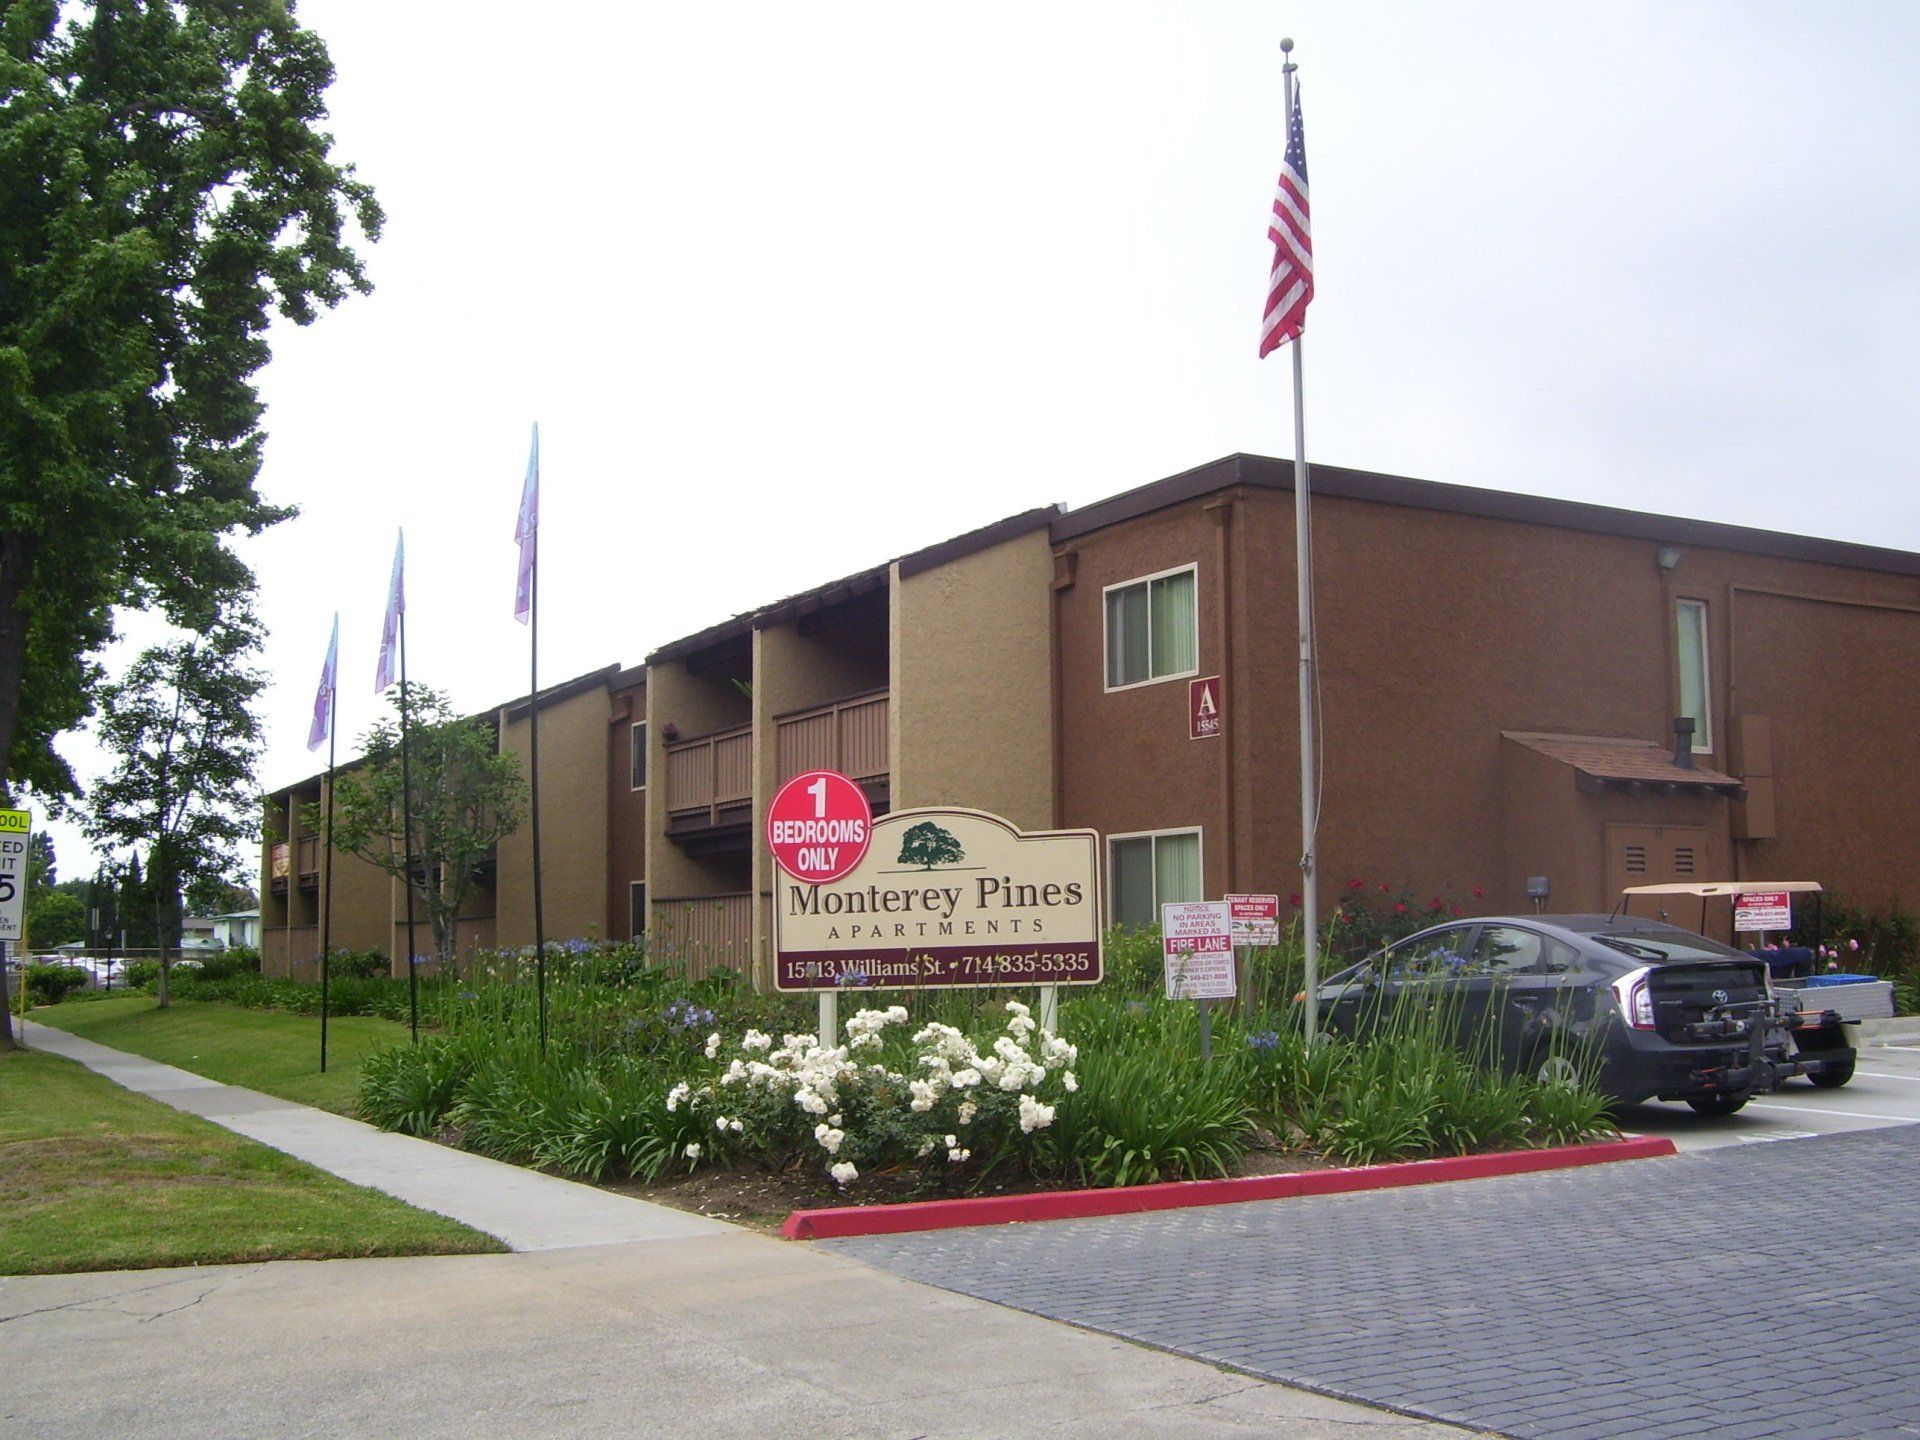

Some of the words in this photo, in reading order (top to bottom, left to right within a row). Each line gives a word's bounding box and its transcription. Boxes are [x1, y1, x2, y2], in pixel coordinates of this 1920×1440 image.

[1197, 682, 1217, 716] A
[1197, 718, 1219, 732] 15545
[807, 778, 826, 818] 1
[773, 819, 865, 844] BEDROOMS
[0, 841, 24, 854] ED
[797, 847, 839, 871] ONLY
[789, 884, 964, 919] Monterey
[975, 876, 1083, 909] Pines
[827, 918, 1043, 940] APARTMENTS
[1175, 928, 1209, 936] MARKED
[1170, 939, 1195, 953] FIRE
[1198, 937, 1227, 951] LANE
[840, 958, 919, 977] Williams
[924, 956, 945, 975] St.
[962, 952, 1089, 974] 714-835-5335
